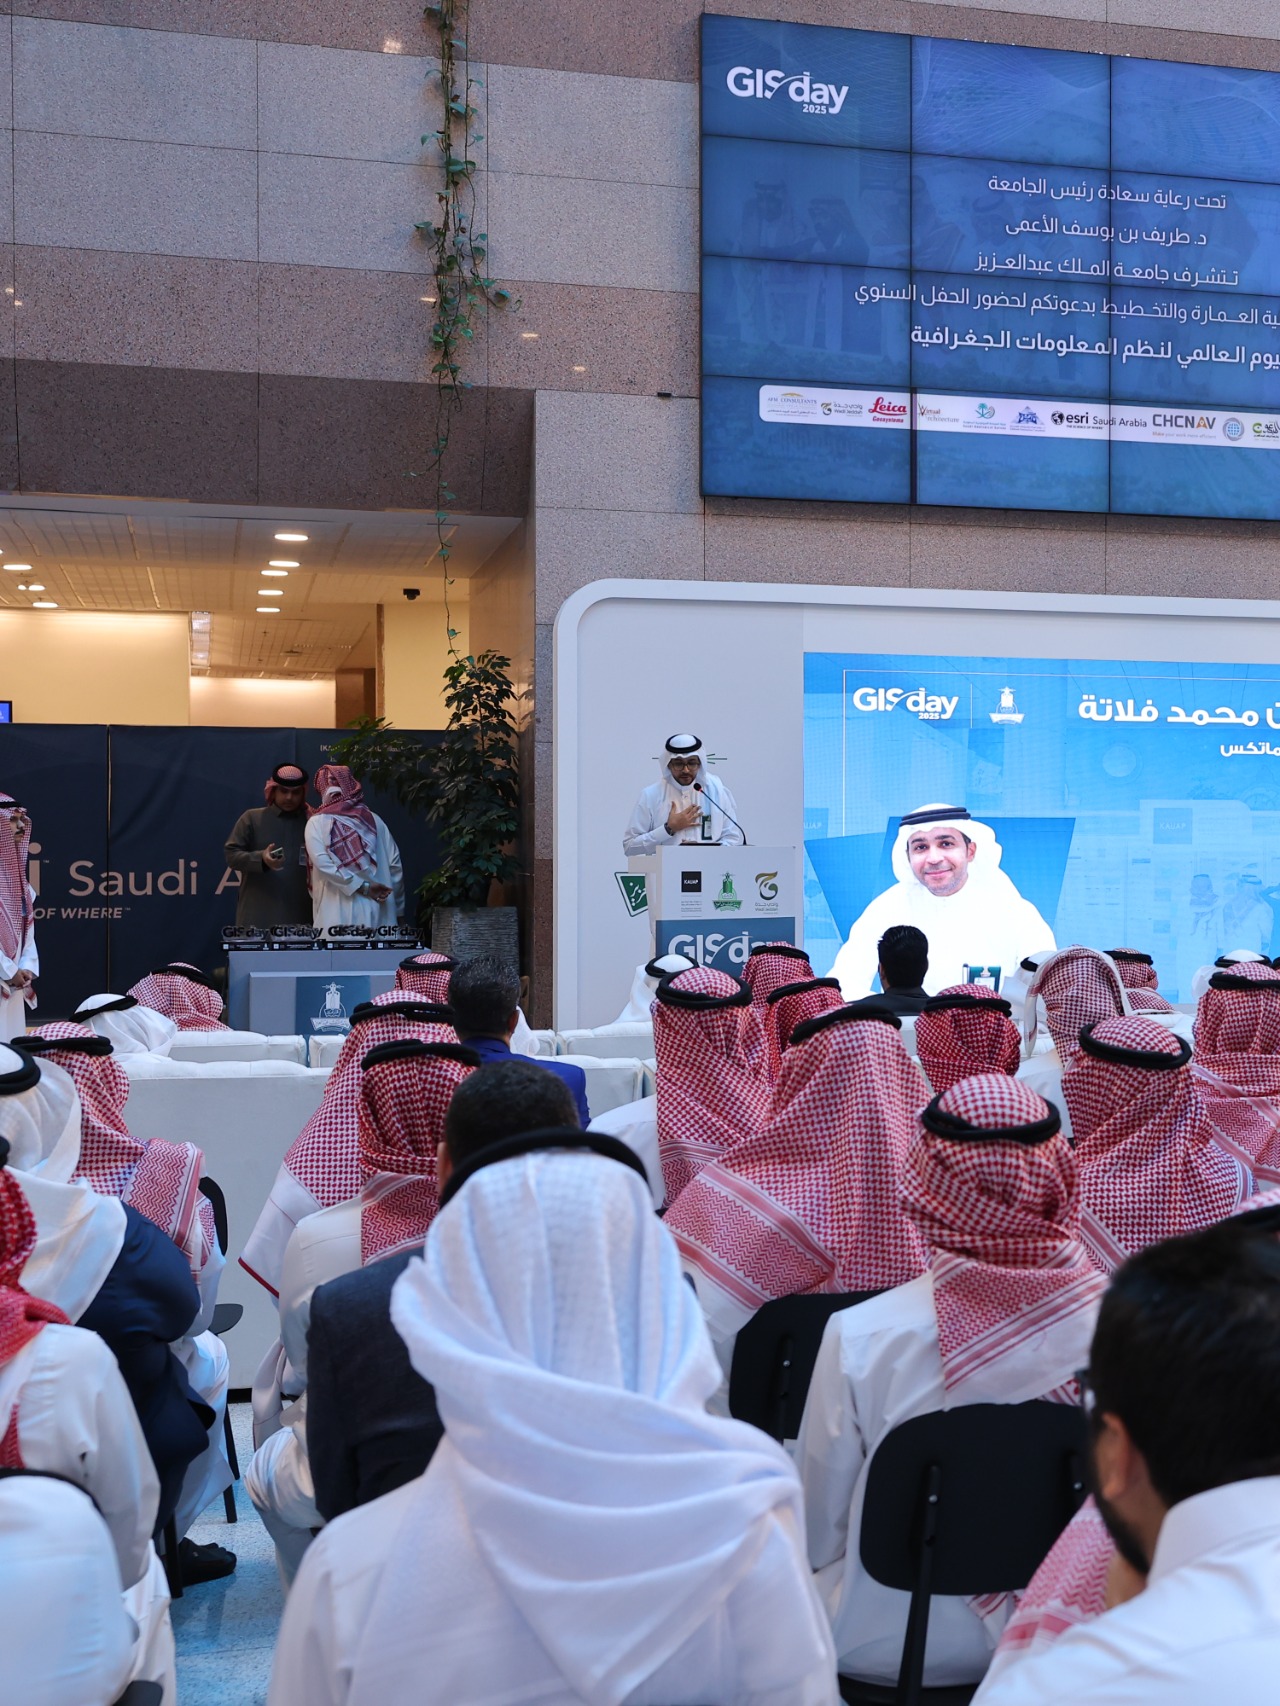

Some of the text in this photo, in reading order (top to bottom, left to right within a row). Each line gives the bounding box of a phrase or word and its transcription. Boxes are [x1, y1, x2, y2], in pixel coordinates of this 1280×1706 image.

[802, 104, 827, 114] 2025
[988, 175, 1226, 210] تحت رعاية سعادة رئيس الجامعة
[1005, 214, 1207, 247] د. طريف بن يوسف الأعمى
[974, 252, 1239, 288] تتشرف جامعة الملك عبدالعزيز
[854, 282, 916, 305] السنوي
[920, 286, 970, 306] الحفل
[973, 290, 1027, 310] لحضور
[1030, 294, 1096, 317] بدعوتكم
[1100, 298, 1187, 324] والتخطيط
[1191, 304, 1258, 325] العمارة
[910, 325, 1010, 352] الجغرافية
[1016, 332, 1118, 357] المعلومات
[1122, 338, 1172, 364] لنظم
[1176, 344, 1245, 369] العالمي
[868, 396, 908, 416] Leica
[872, 416, 904, 424] Geosystems
[1066, 412, 1148, 428] esri Saudi Arabia
[1152, 414, 1216, 430] CHCNAV
[918, 712, 940, 720] 2025
[1078, 694, 1160, 722] فلاتة
[1166, 705, 1260, 727] محمد
[68, 858, 198, 897] Saudi
[33, 908, 56, 920] OF
[667, 931, 787, 964] GISd
